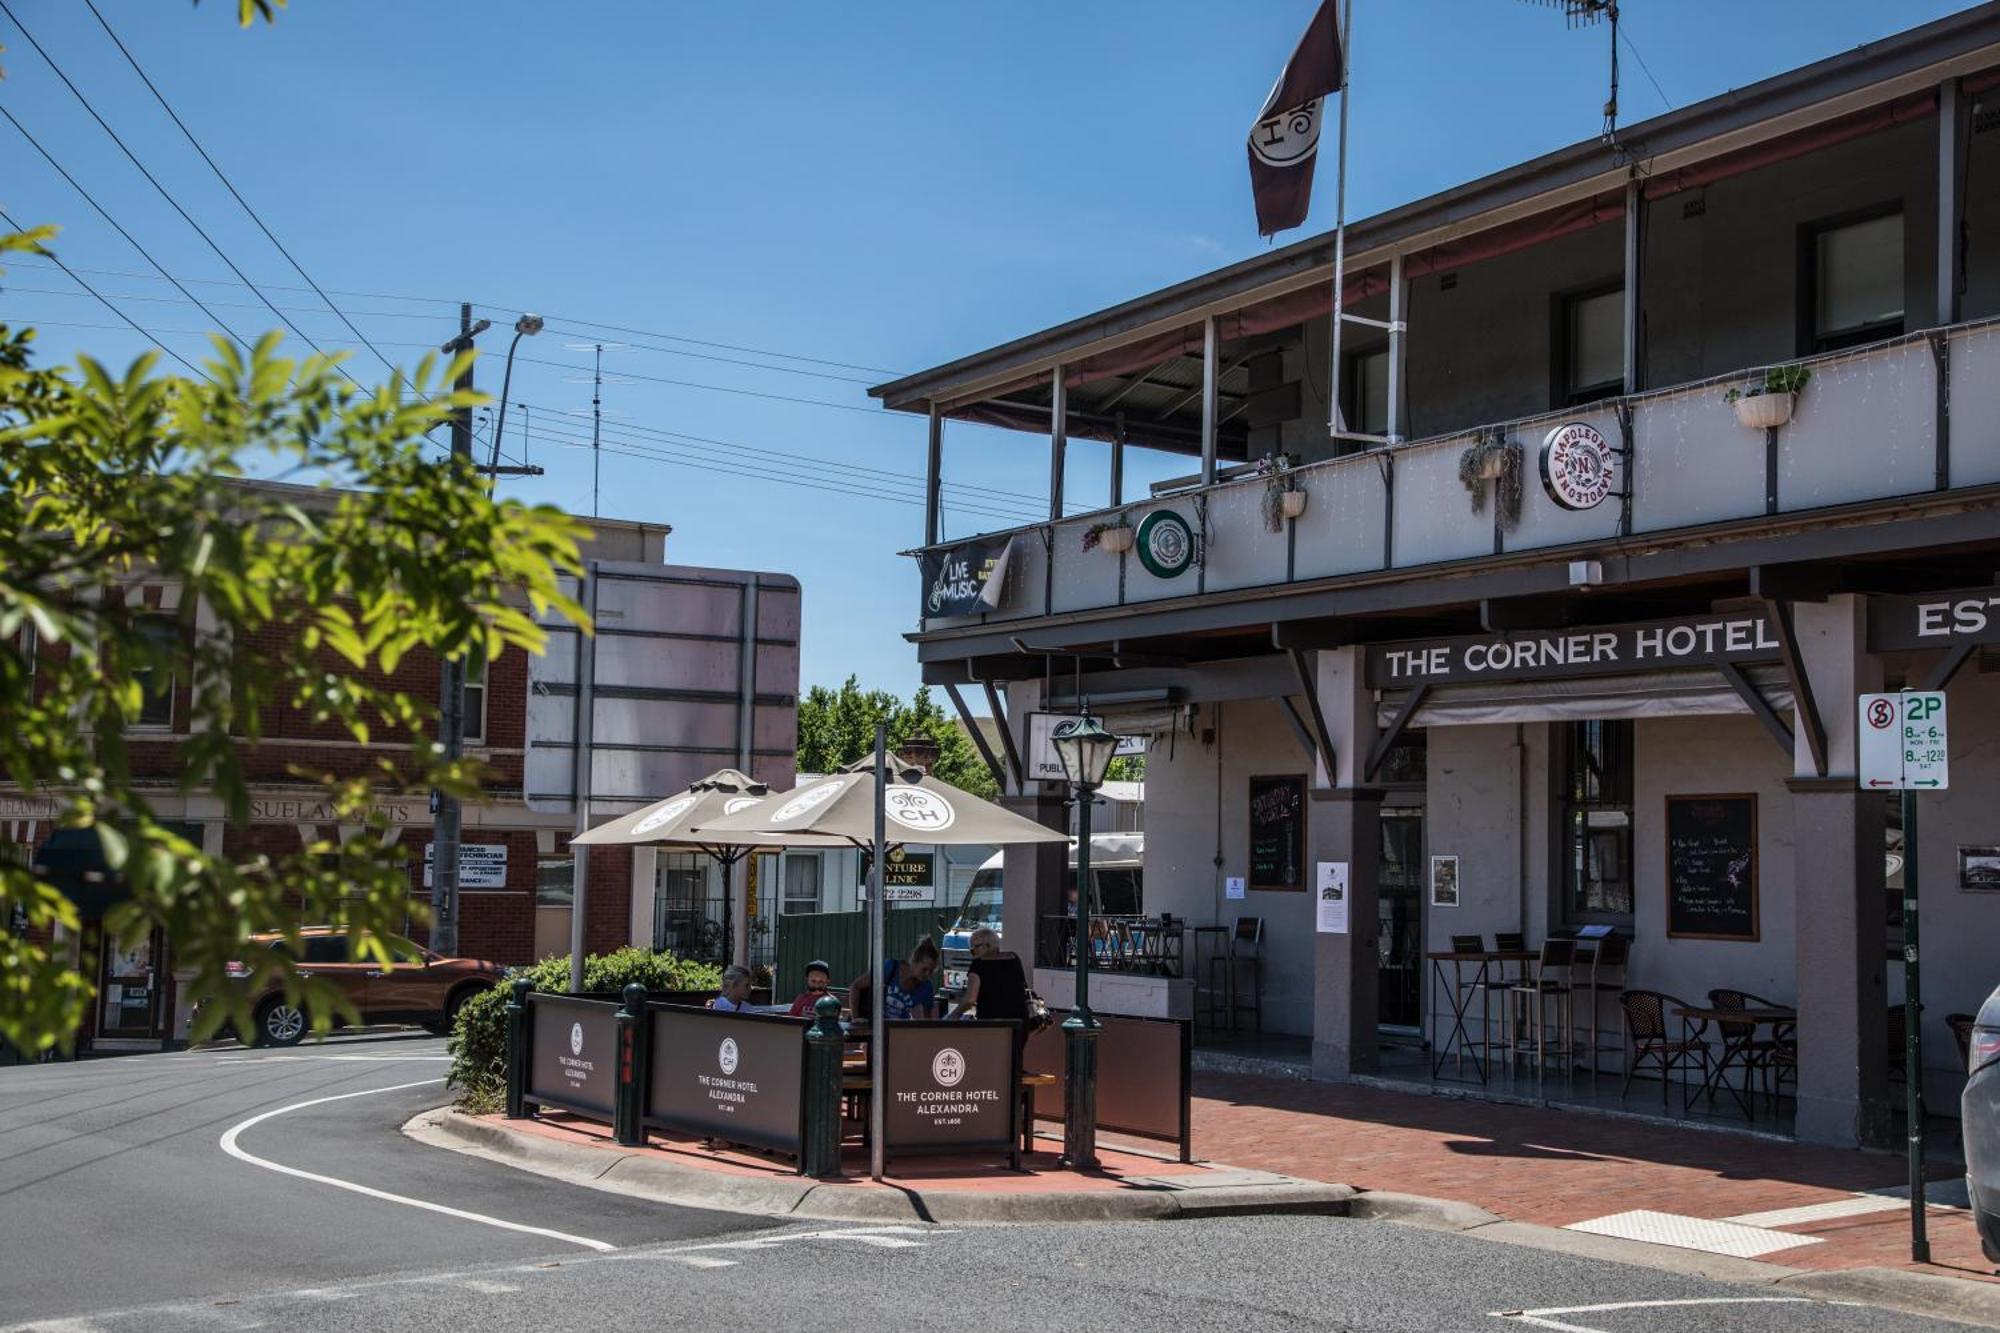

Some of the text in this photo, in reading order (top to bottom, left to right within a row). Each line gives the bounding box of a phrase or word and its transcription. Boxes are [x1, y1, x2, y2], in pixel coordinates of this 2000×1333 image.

[943, 580, 977, 600] MUSIC
[1386, 619, 1780, 677] THE CORNER HOTEL
[1906, 697, 1942, 720] 2P
[1040, 763, 1064, 773] PUBL
[899, 810, 940, 822] CH
[885, 875, 918, 884] LINIC
[940, 1068, 957, 1078] CH
[698, 1075, 758, 1093] THE CORNER HOTEL
[709, 1089, 745, 1103] ALEXANDRA
[896, 1090, 999, 1102] THE CORNER HOTEL
[917, 1103, 979, 1114] ALEXANDRA
